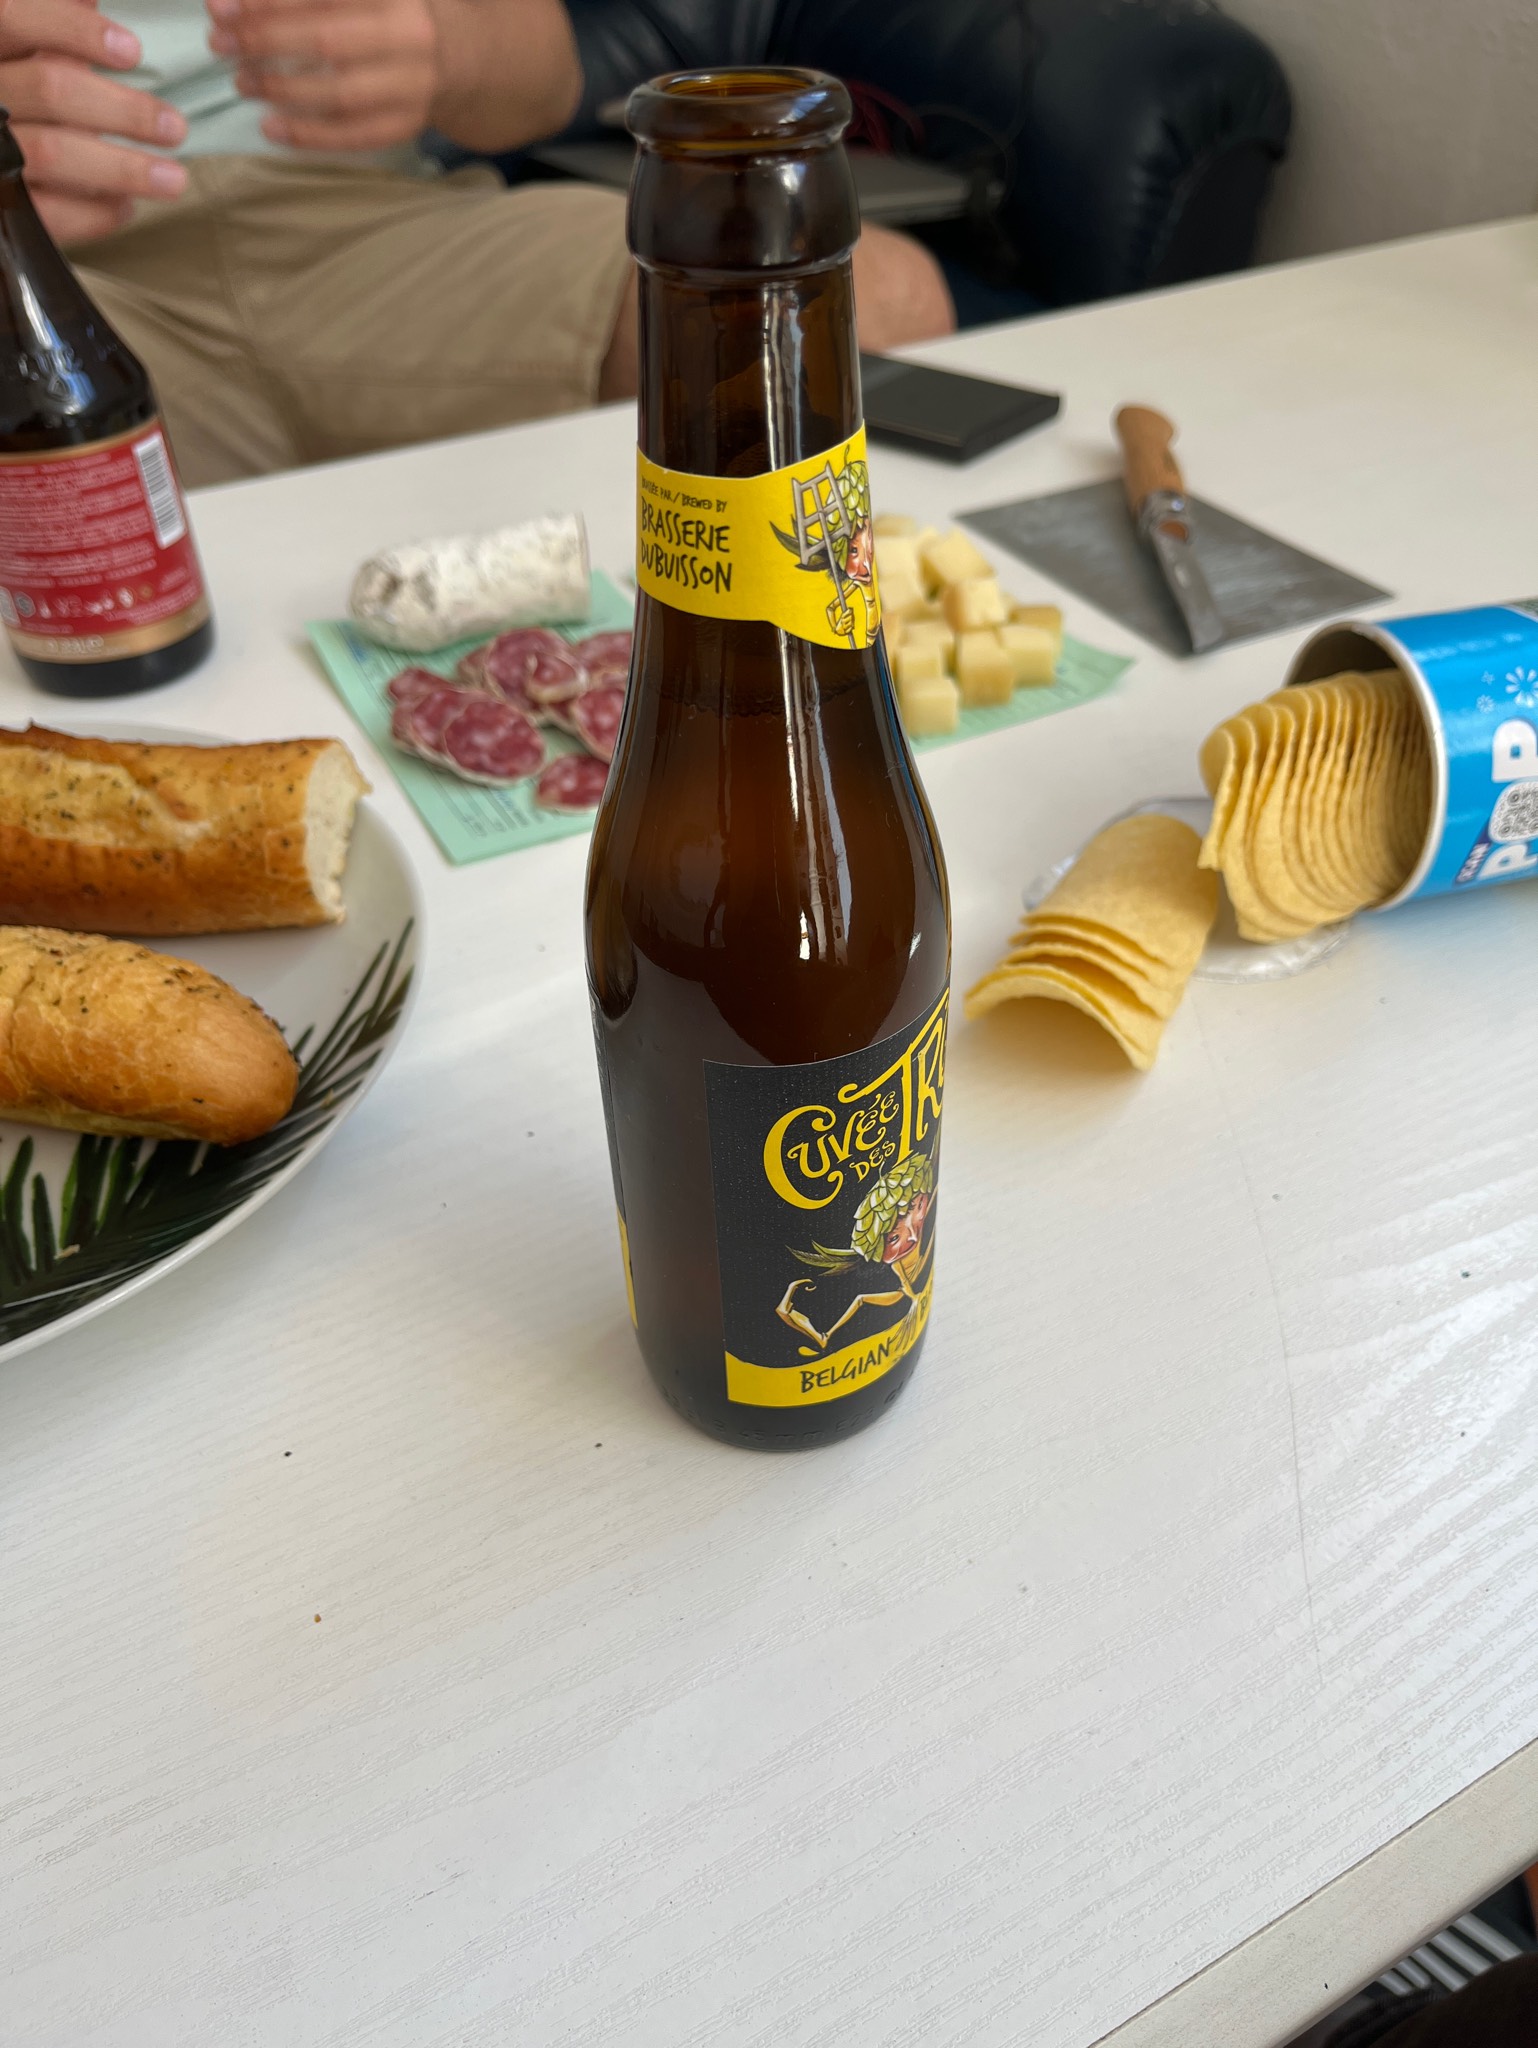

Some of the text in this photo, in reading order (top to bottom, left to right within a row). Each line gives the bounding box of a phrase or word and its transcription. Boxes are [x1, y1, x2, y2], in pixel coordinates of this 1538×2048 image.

[642, 496, 730, 553] BRASSERIE
[660, 487, 672, 502] PAR
[682, 493, 712, 510] BREWED
[716, 499, 727, 513] BY
[641, 538, 732, 594] DUBUISSON
[838, 987, 949, 1168] TR
[849, 1141, 896, 1183] DES
[800, 1336, 891, 1394] BELGIAN
